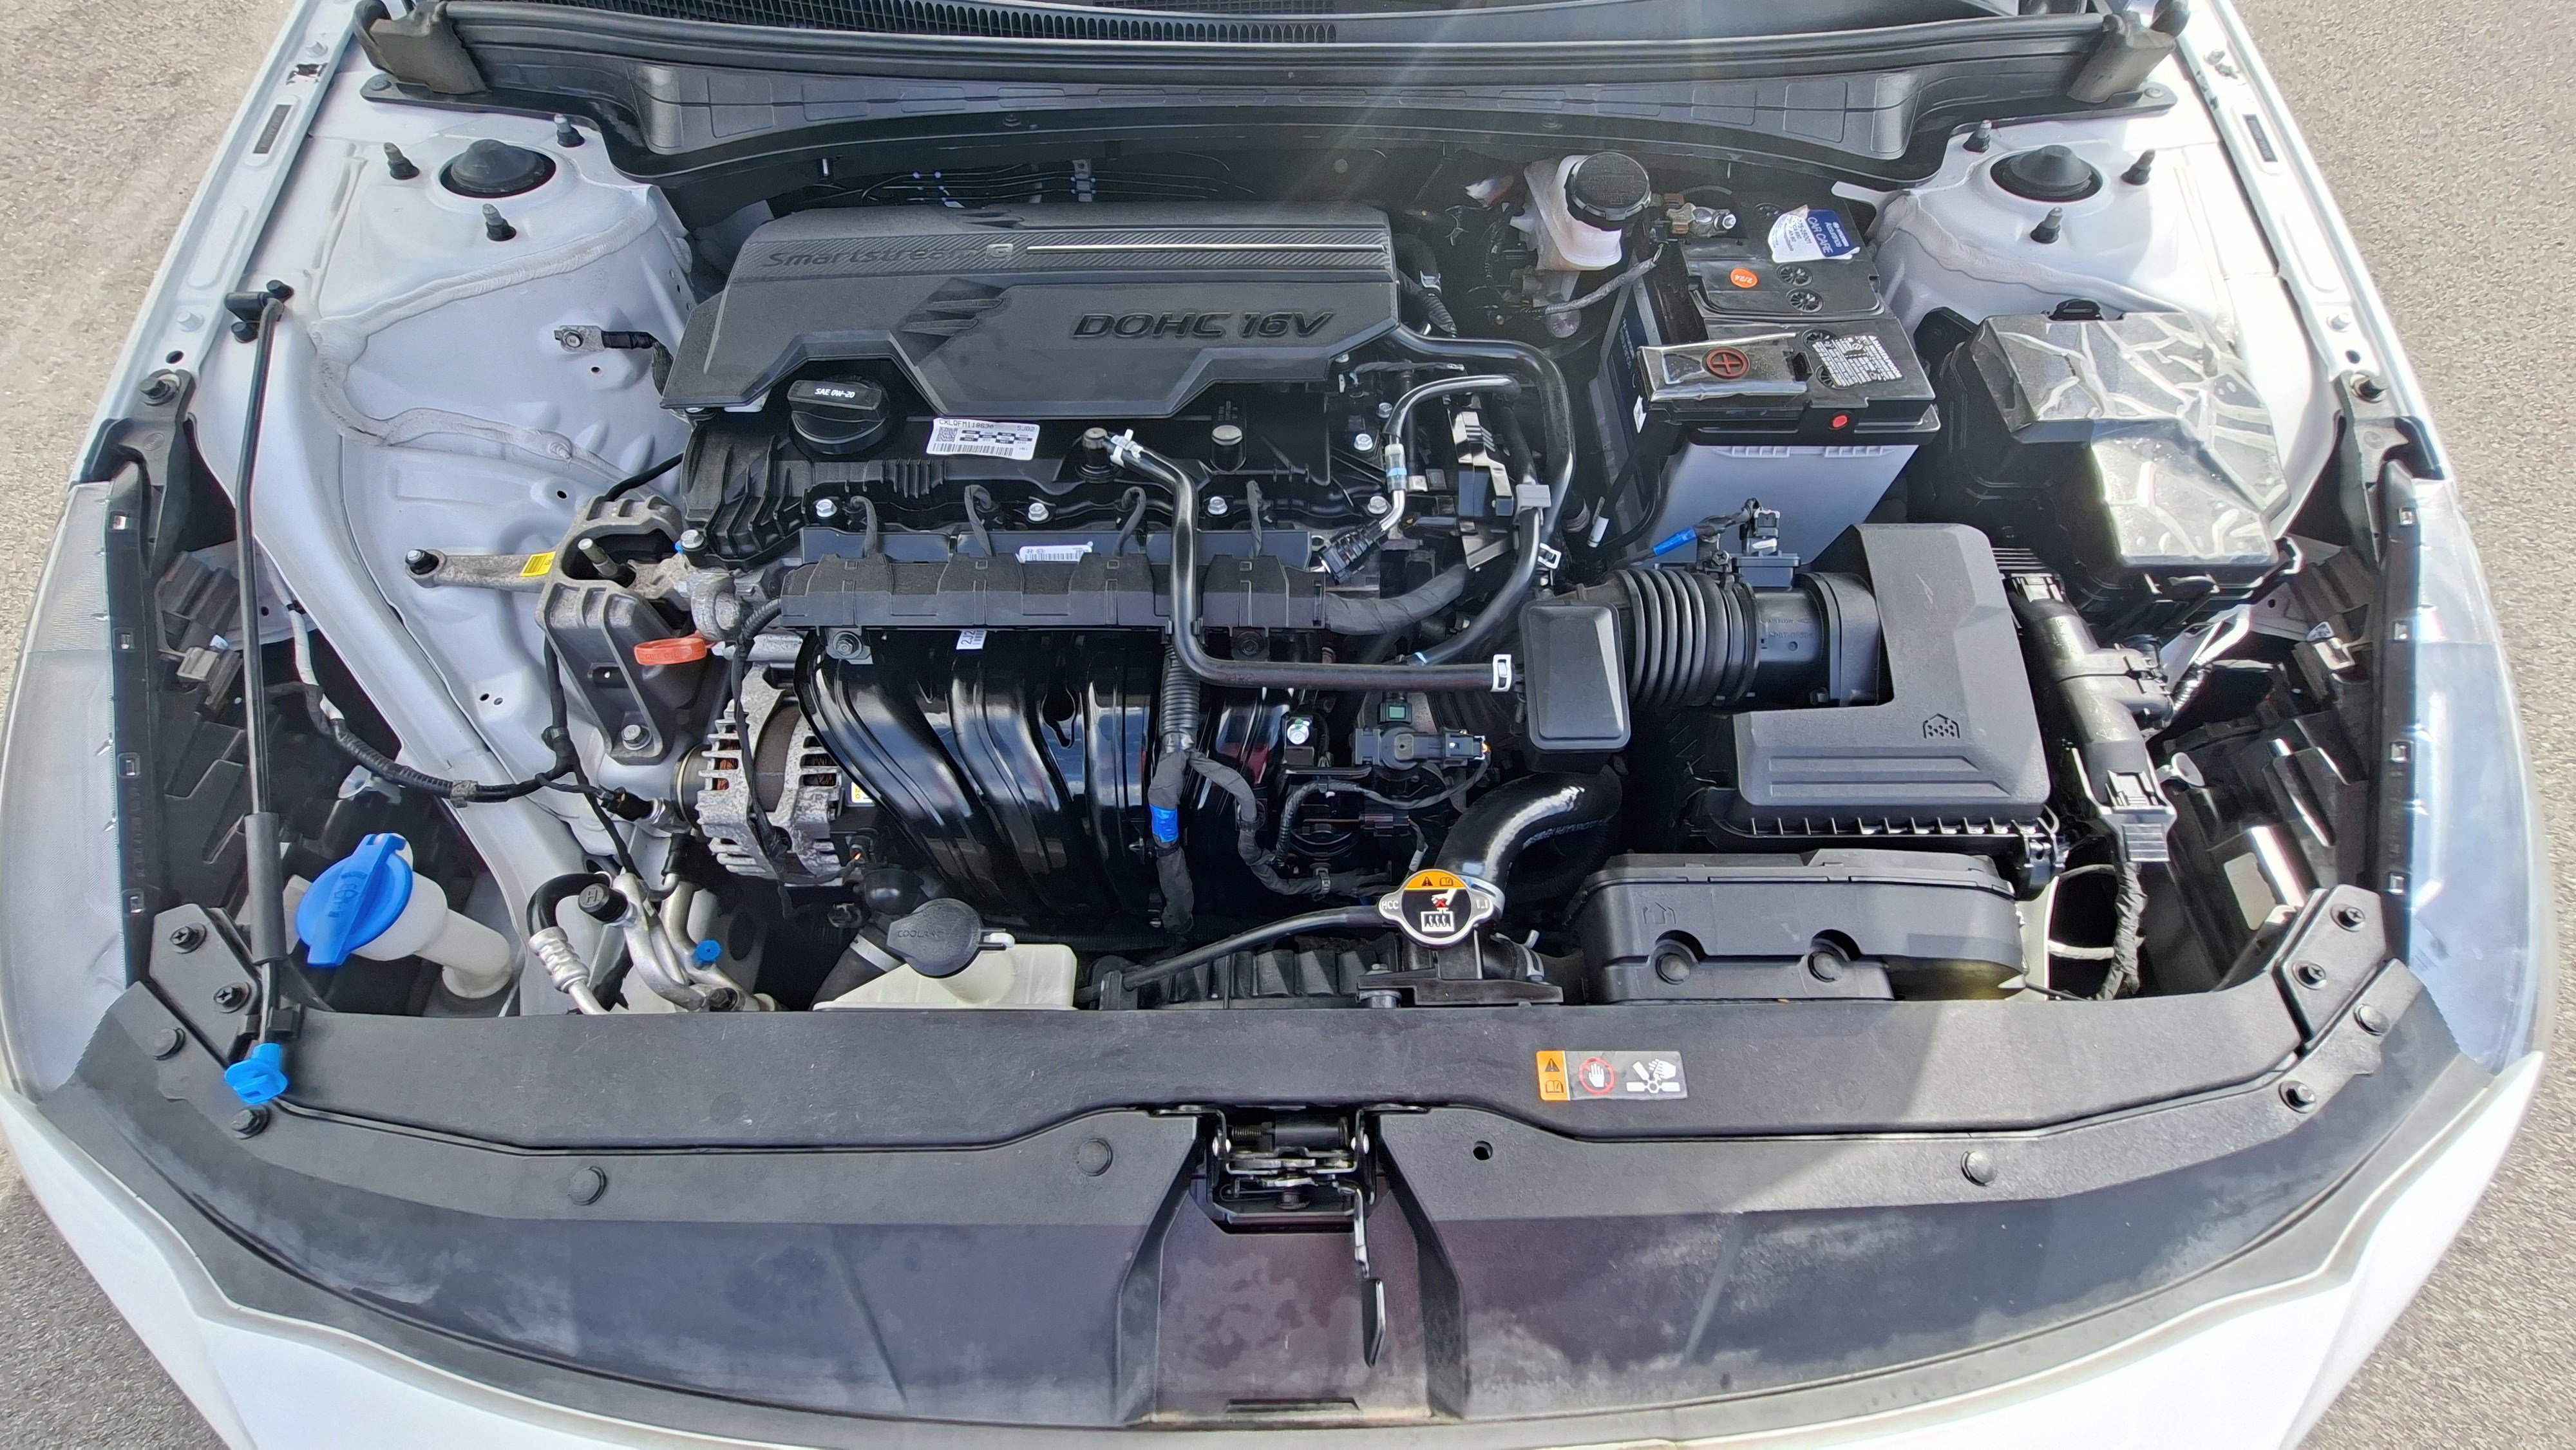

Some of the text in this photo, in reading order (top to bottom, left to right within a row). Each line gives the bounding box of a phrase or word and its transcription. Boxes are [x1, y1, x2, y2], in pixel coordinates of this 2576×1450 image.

[1808, 216, 1833, 254] CAR CARE
[762, 248, 978, 268] Smartstream
[1073, 312, 1332, 339] DOHC 16V
[831, 389, 855, 398] 0W-20
[1381, 900, 1399, 910] HCC
